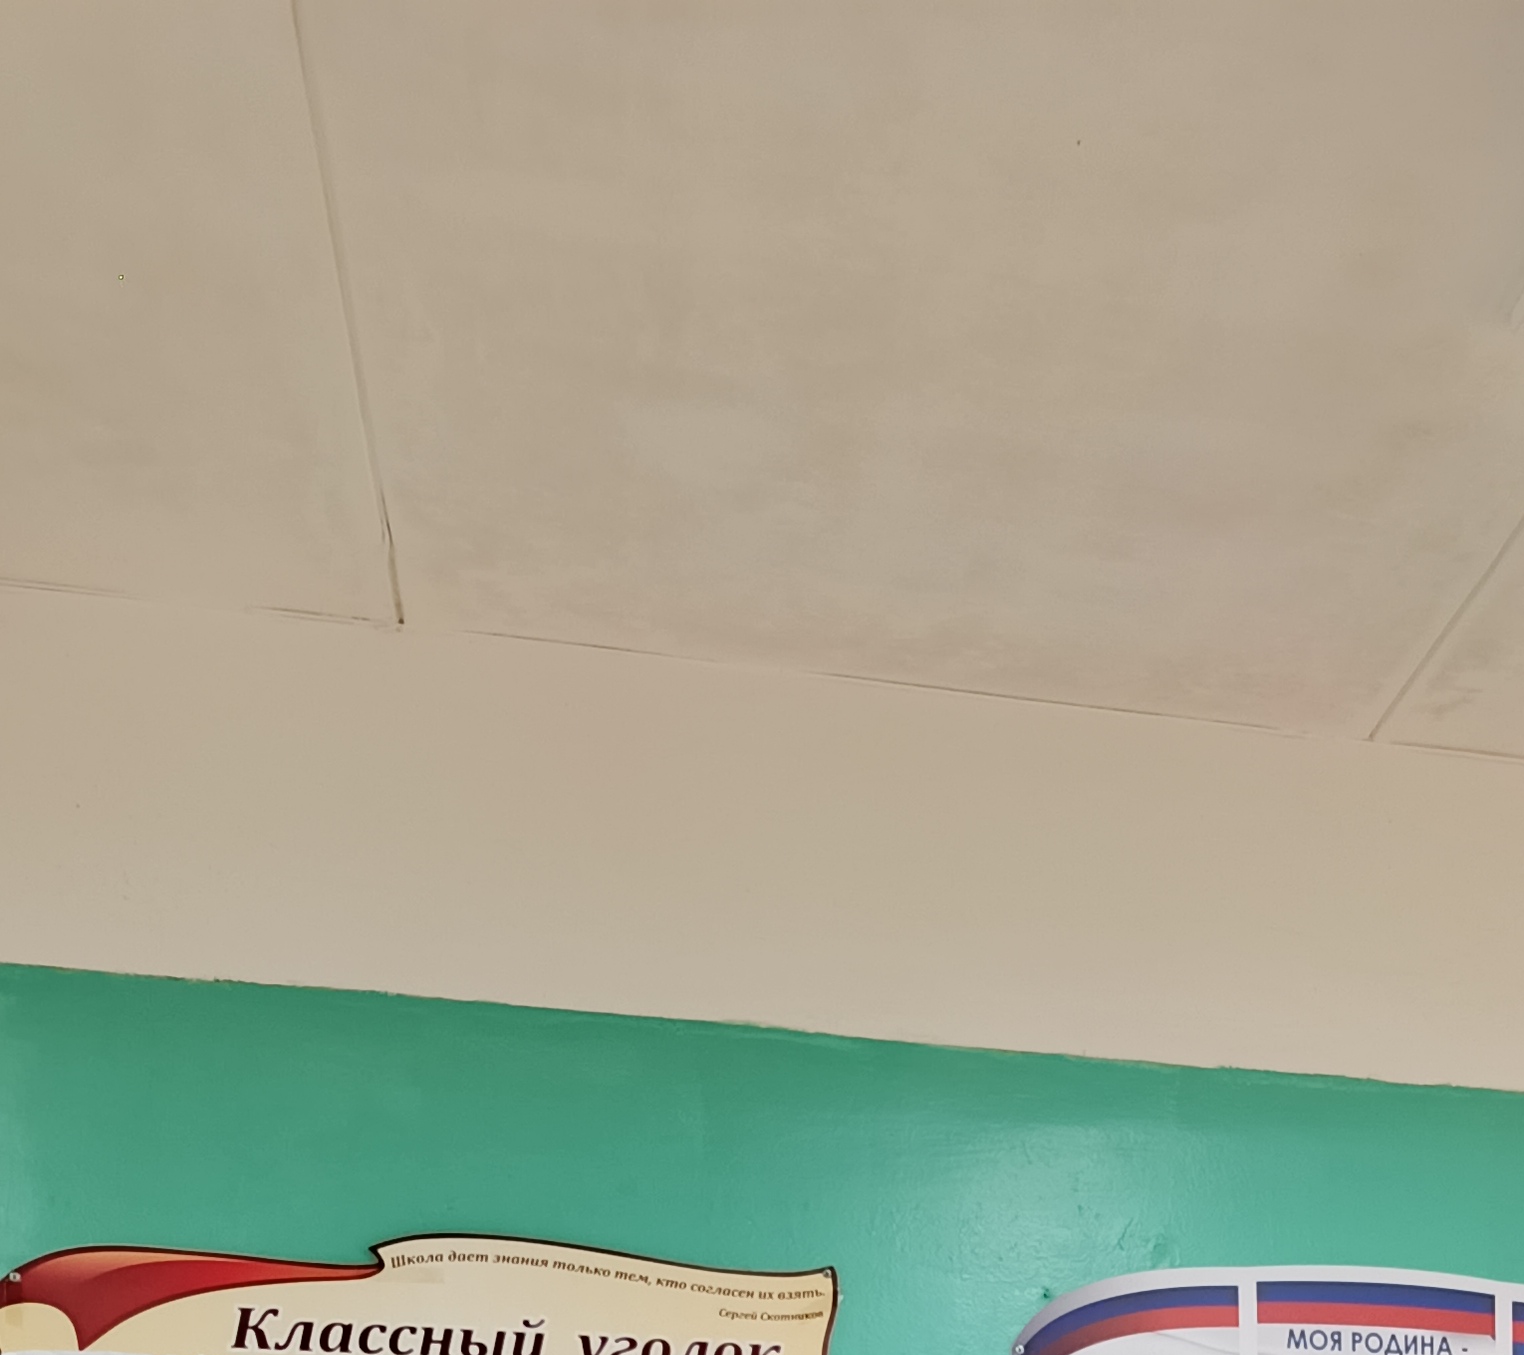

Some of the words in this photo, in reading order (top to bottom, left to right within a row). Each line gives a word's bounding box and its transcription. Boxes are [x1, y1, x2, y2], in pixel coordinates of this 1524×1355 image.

[390, 1253, 444, 1269] Школа
[447, 1250, 489, 1263] дает
[492, 1255, 549, 1269] знания
[552, 1260, 611, 1278] только
[614, 1269, 652, 1287] тем,
[656, 1277, 687, 1291] кто
[690, 1283, 755, 1299] согласен
[758, 1291, 774, 1301] их
[1286, 1328, 1342, 1352] МОЯ
